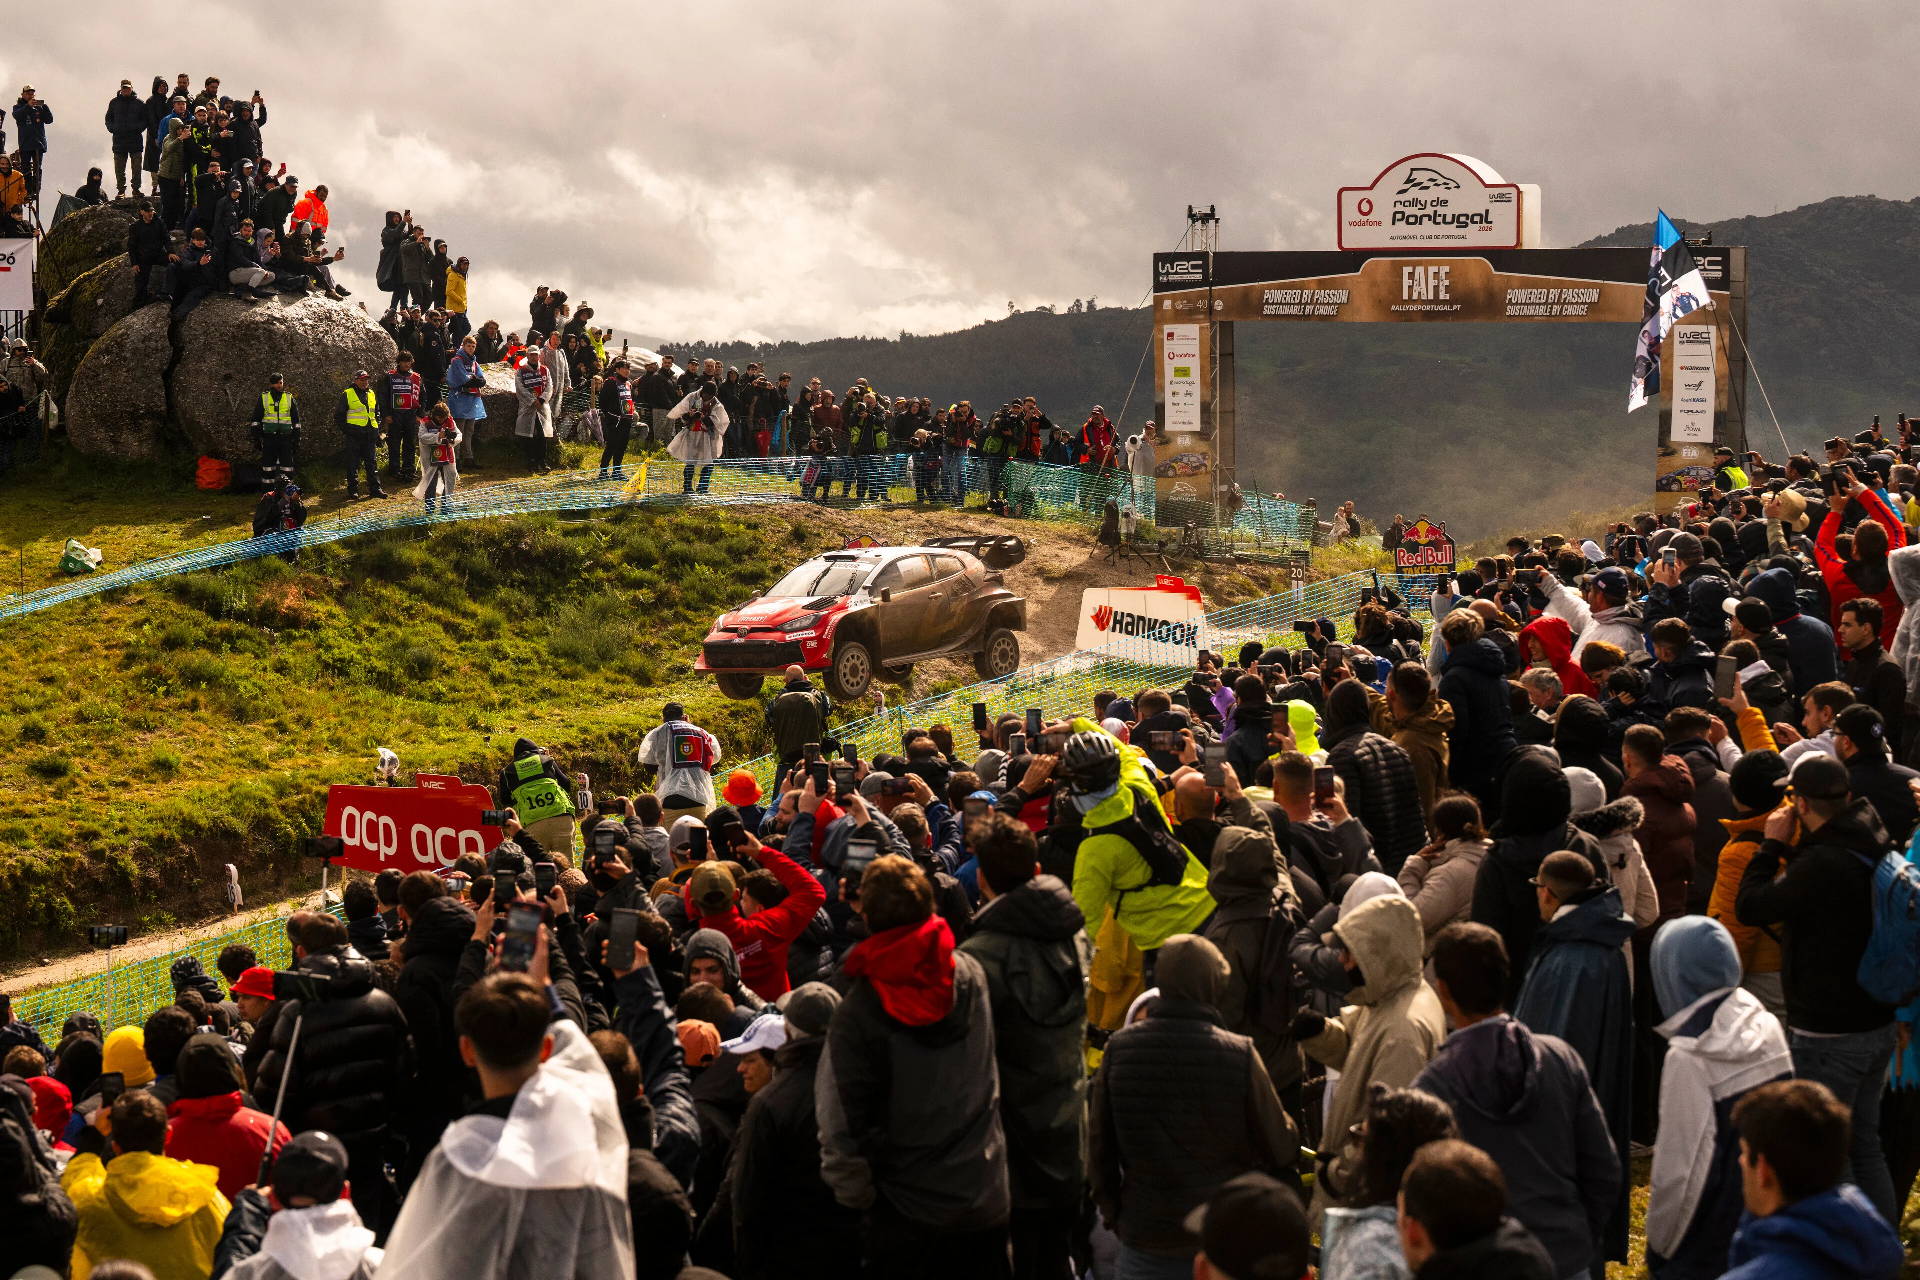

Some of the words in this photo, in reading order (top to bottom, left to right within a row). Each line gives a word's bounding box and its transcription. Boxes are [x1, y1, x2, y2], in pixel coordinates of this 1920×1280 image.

[1393, 197, 1428, 210] rally
[1430, 197, 1449, 208] de
[1348, 219, 1382, 227] vodafone
[1392, 209, 1493, 229] Portugal
[1159, 261, 1202, 273] WRC
[1402, 266, 1450, 300] FAFE
[1263, 289, 1302, 304] POWERED
[1302, 289, 1314, 304] BY
[1314, 289, 1349, 304] PASSION
[1505, 288, 1548, 303] POWERED
[1548, 288, 1561, 303] BY
[1561, 288, 1600, 303] PASSION
[1263, 304, 1304, 315] SUSTAINABLE
[1305, 304, 1314, 315] BY
[1314, 304, 1339, 315] CHOICE
[1506, 304, 1551, 316] SUSTAINABLE
[1552, 304, 1562, 316] BY
[1562, 304, 1588, 316] CHOICE
[1679, 331, 1710, 339] WRC
[413, 384, 421, 400] 237
[1397, 545, 1424, 566] Red
[1424, 545, 1453, 565] Bull
[1291, 567, 1303, 578] 20
[422, 780, 446, 790] WRC
[526, 792, 556, 810] 169
[579, 792, 589, 808] 10
[341, 805, 398, 861] acp
